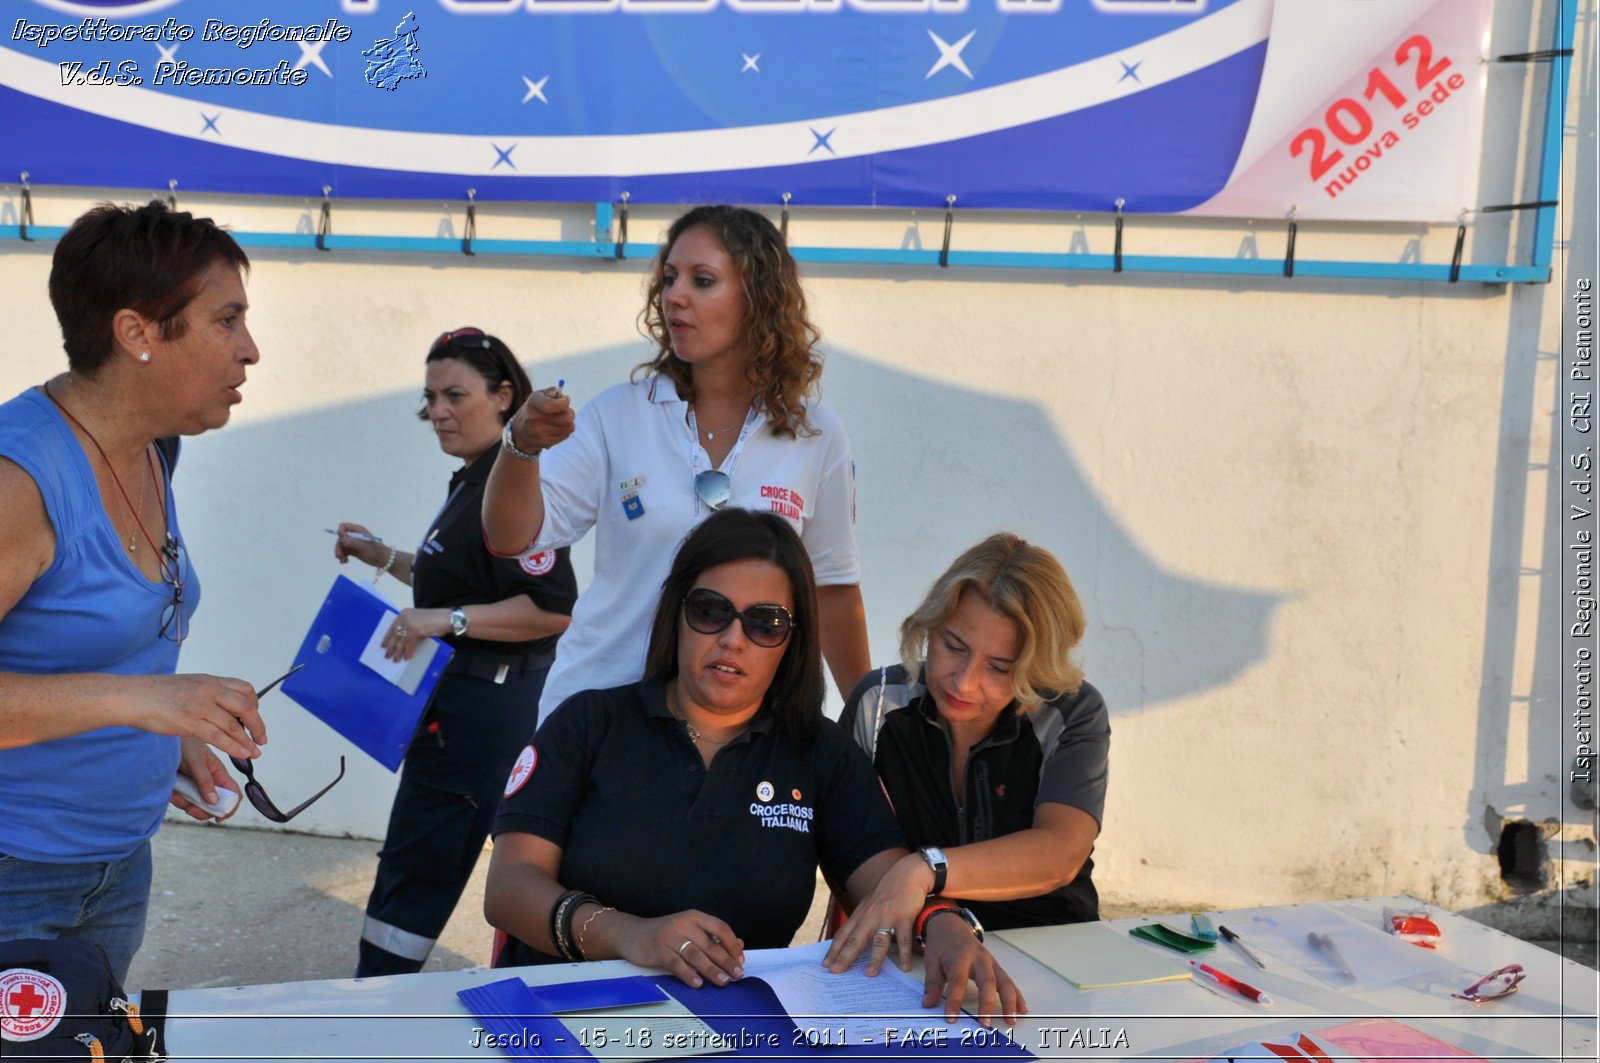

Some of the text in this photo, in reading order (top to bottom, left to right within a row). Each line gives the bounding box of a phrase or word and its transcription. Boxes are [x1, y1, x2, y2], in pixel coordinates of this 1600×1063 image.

[1289, 34, 1453, 182] 2012
[1323, 70, 1467, 199] nuova sede
[760, 485, 789, 501] CROCE
[749, 802, 814, 820] CROCE ROSS
[761, 816, 809, 833] ITALIANA
[13, 1022, 42, 1032] ROSSA
